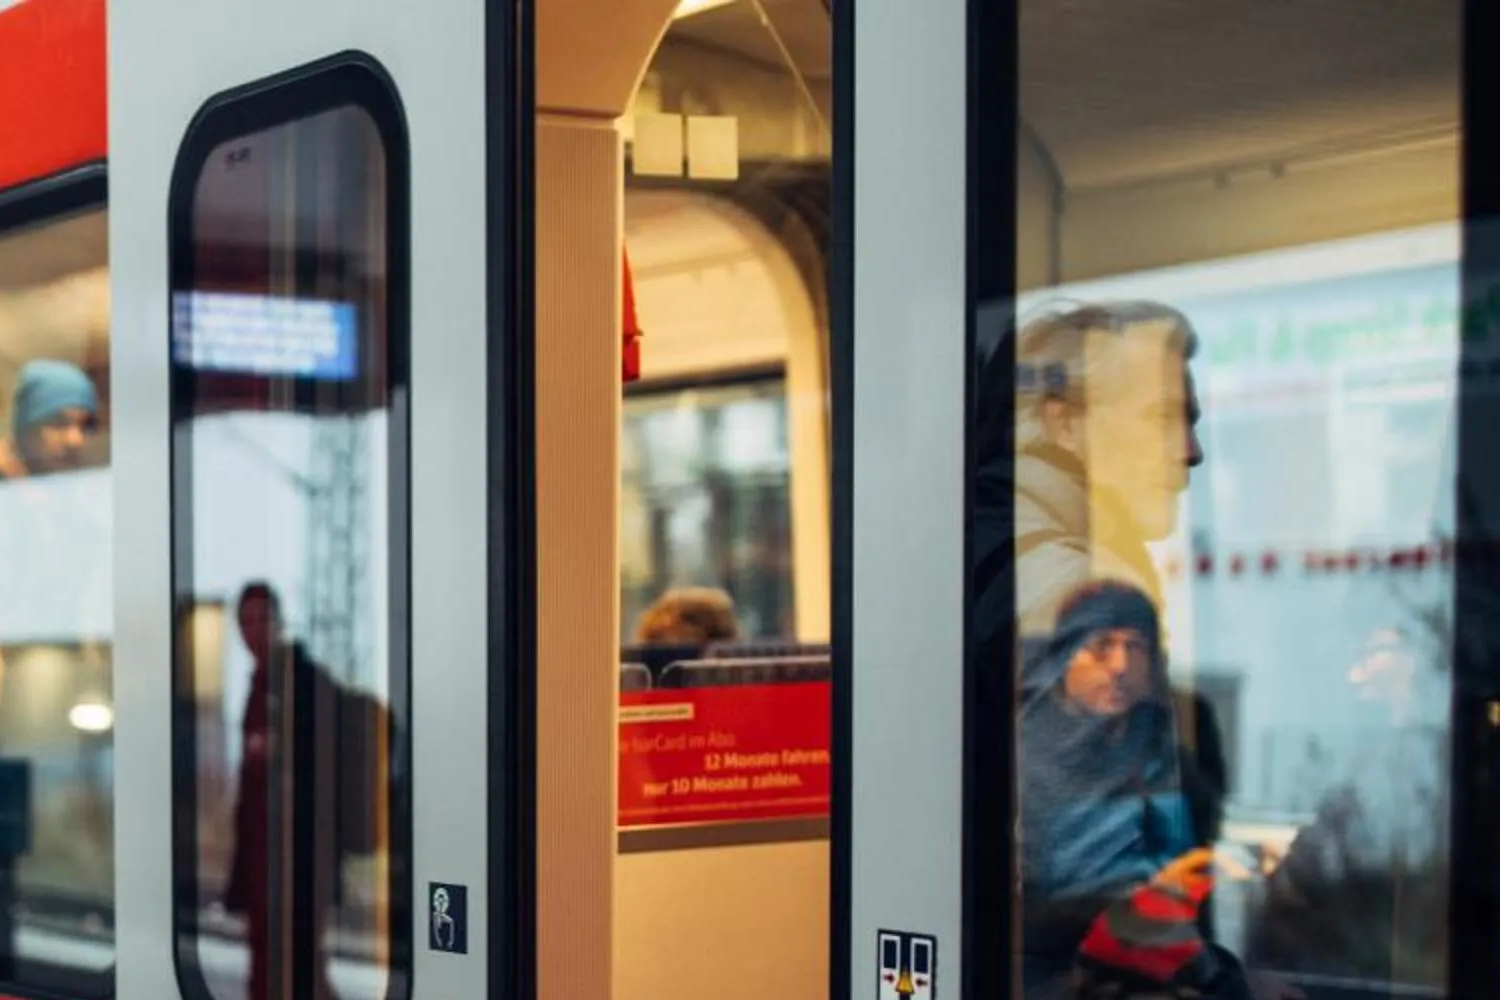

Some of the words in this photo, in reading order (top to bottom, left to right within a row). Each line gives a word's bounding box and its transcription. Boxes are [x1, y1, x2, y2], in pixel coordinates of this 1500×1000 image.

[704, 753, 721, 770] 12
[724, 751, 779, 769] Monate
[672, 778, 690, 795] 10
[693, 775, 748, 793] Monate
